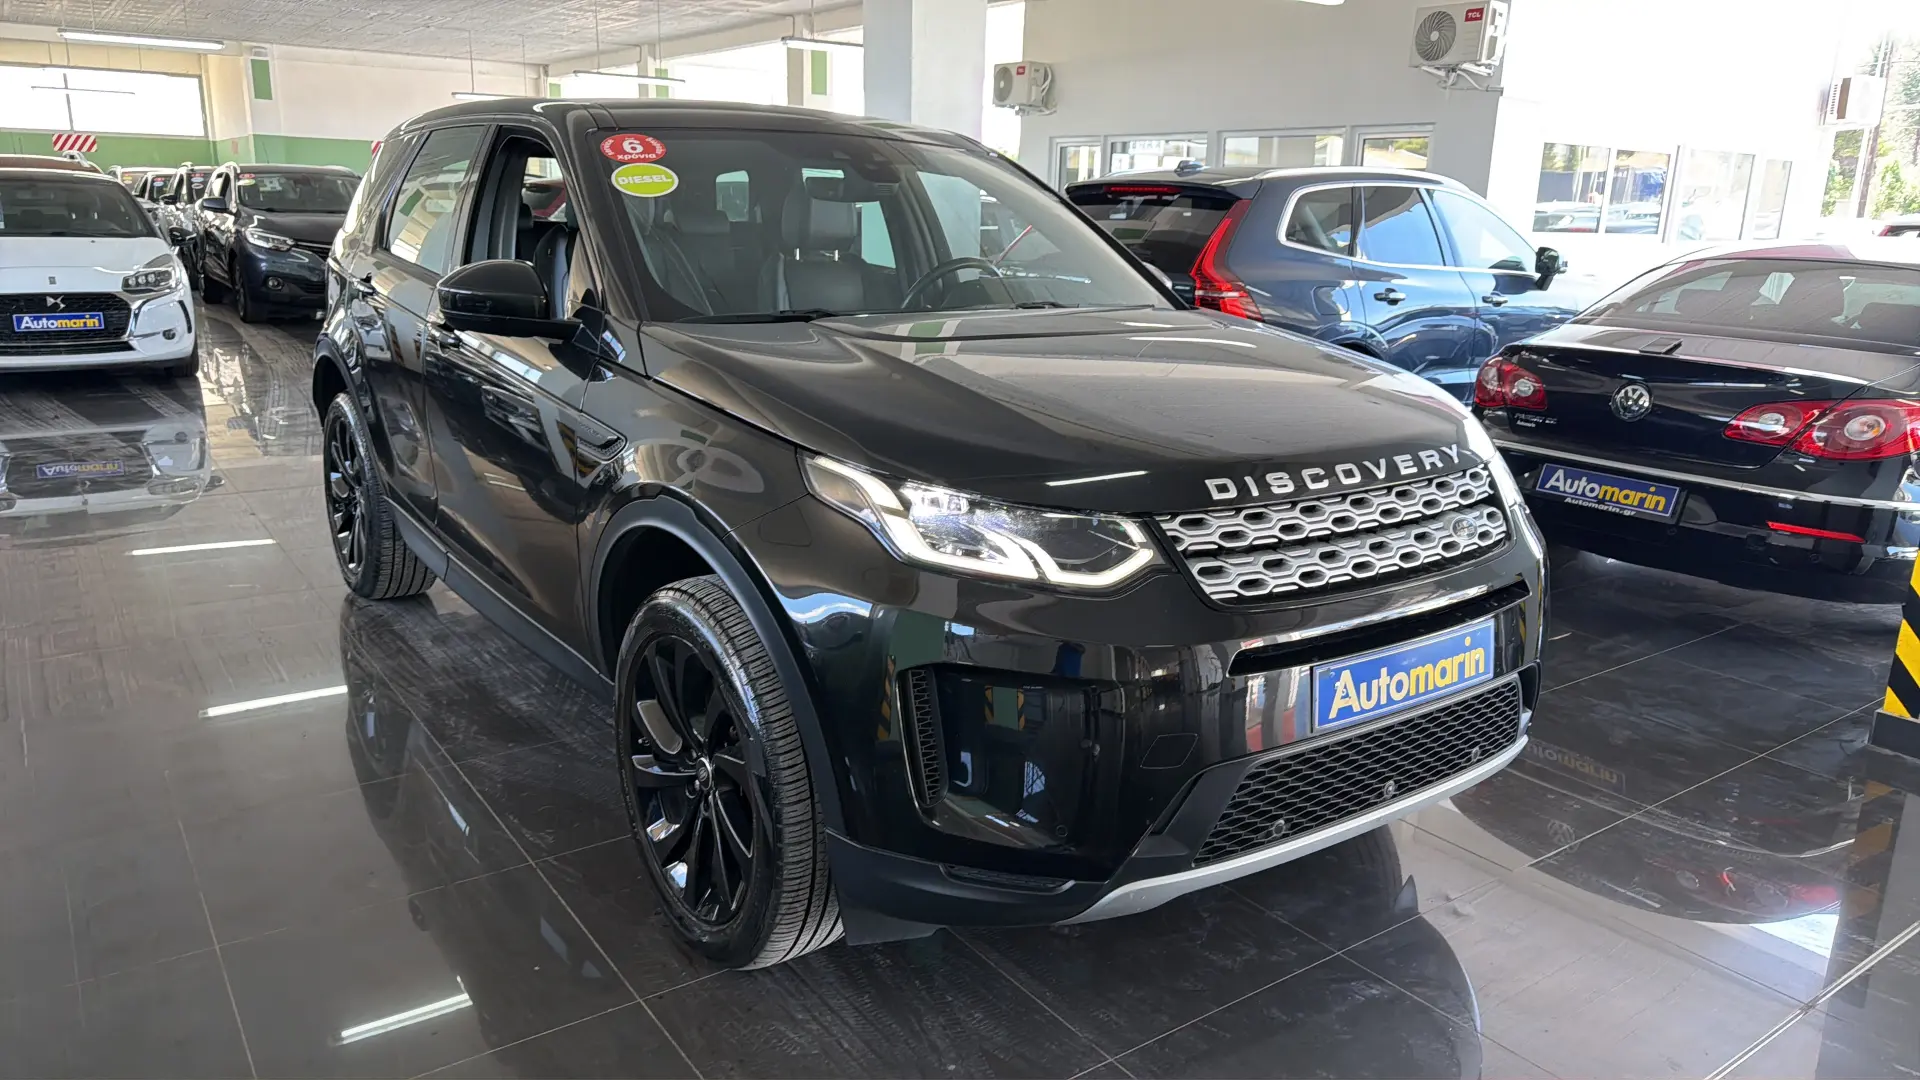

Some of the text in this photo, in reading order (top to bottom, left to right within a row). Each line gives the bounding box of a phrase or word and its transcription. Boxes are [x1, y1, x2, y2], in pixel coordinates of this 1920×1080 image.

[622, 140, 643, 154] 6
[618, 175, 673, 184] DIESEL
[20, 315, 99, 329] Automarin
[1205, 444, 1460, 500] DISCOVERY
[1544, 469, 1666, 511] Automarin
[1564, 497, 1637, 516] Automarin.gr
[1328, 636, 1485, 720] Automarin
